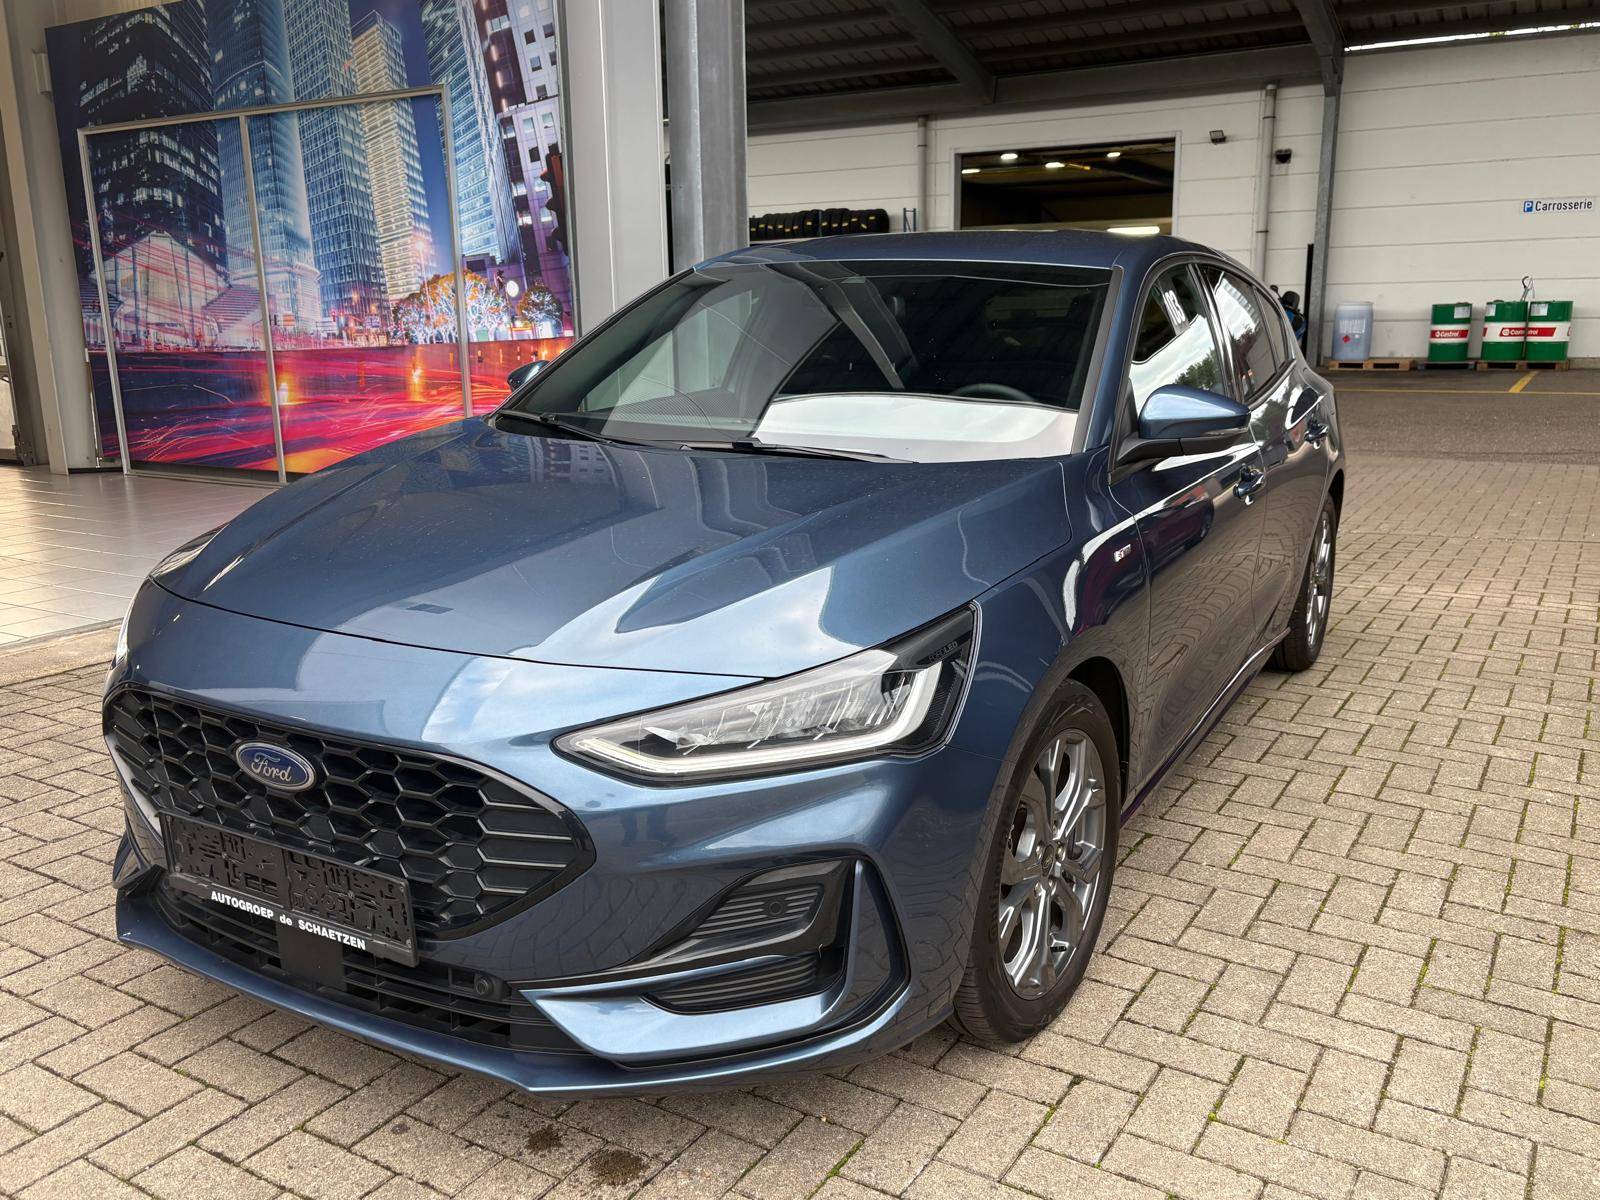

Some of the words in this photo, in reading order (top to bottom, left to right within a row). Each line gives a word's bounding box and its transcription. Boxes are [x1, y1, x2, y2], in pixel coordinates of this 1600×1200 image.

[1535, 198, 1592, 212] Carrosserie
[251, 752, 292, 782] Ford
[211, 891, 274, 920] AUTOGROEP
[279, 914, 293, 926] de
[298, 919, 366, 950] SCHAETZEN
